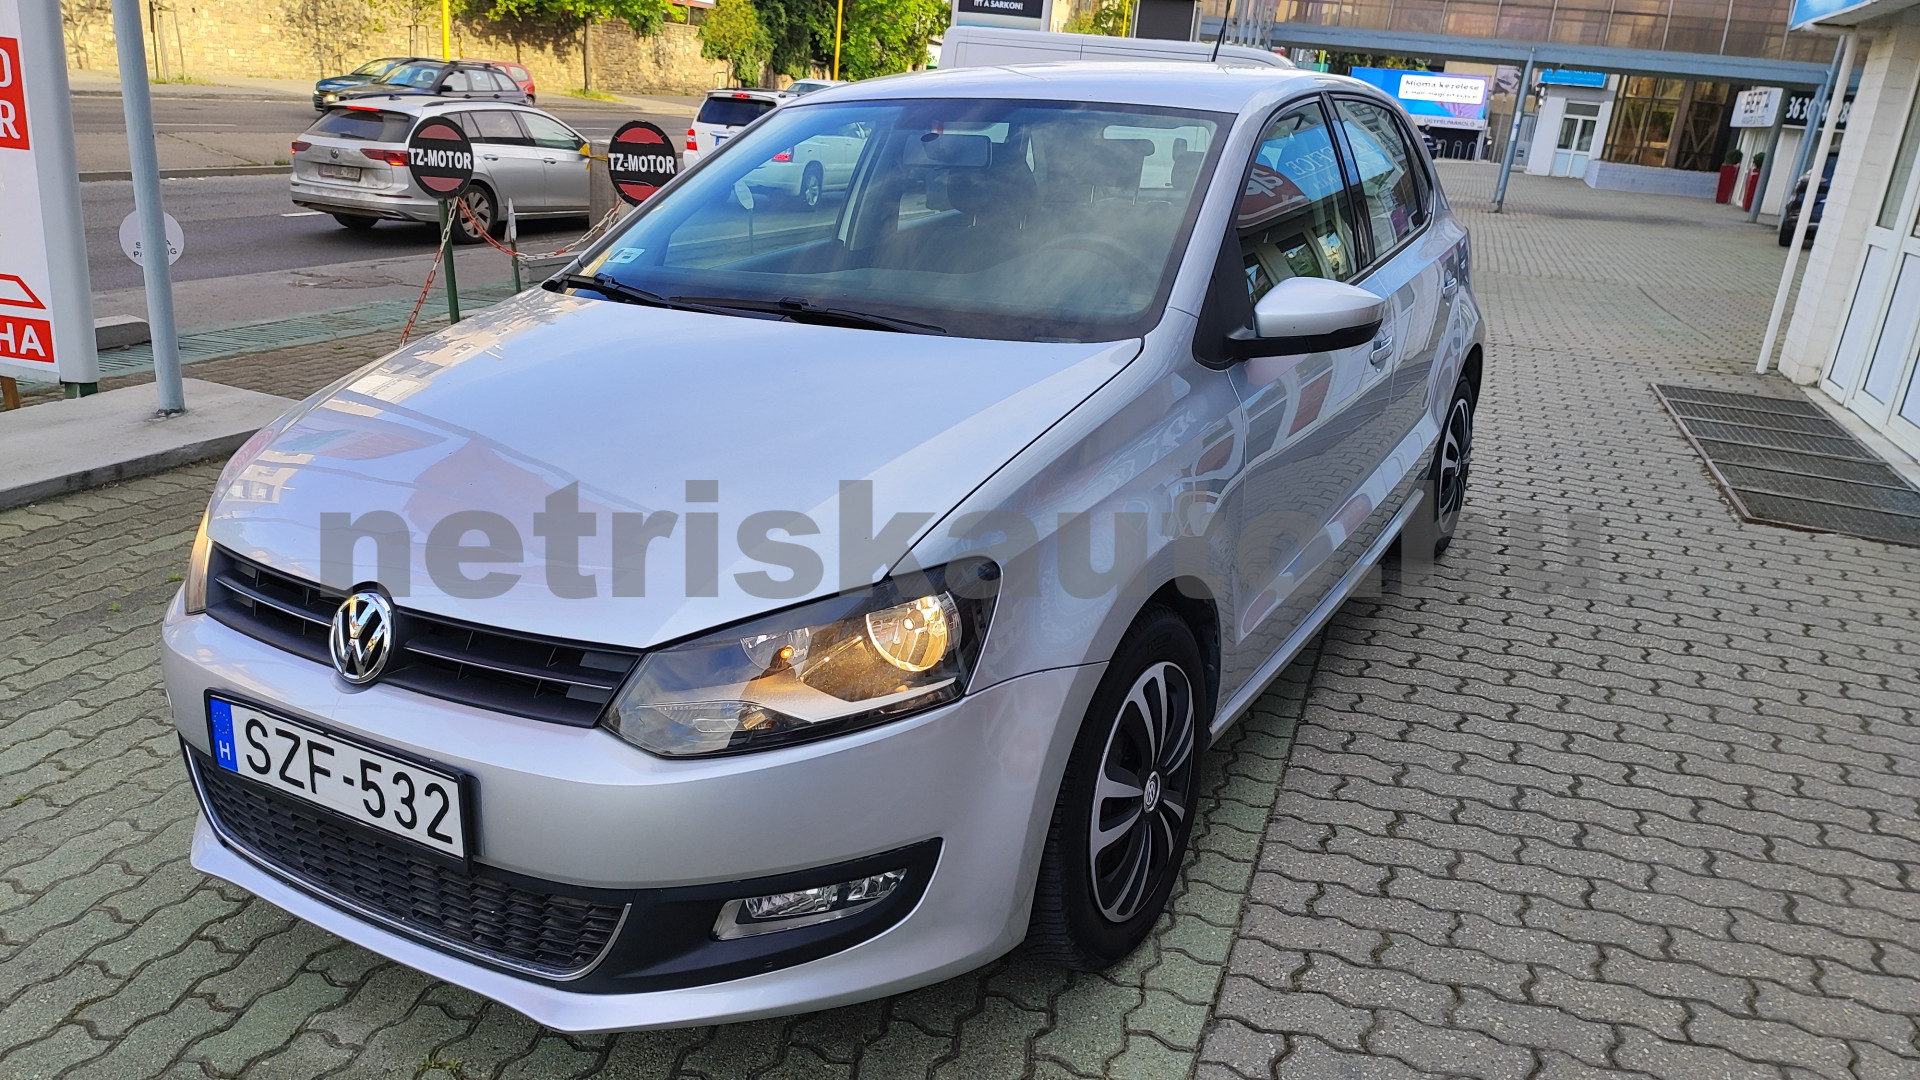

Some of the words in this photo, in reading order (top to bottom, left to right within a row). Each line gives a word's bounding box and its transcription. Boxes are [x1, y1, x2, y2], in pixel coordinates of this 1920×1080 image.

[408, 148, 473, 170] TZ-MOTOR
[608, 152, 676, 174] TZ-MOTOR
[219, 740, 231, 761] H
[245, 718, 453, 845] SZF-532
